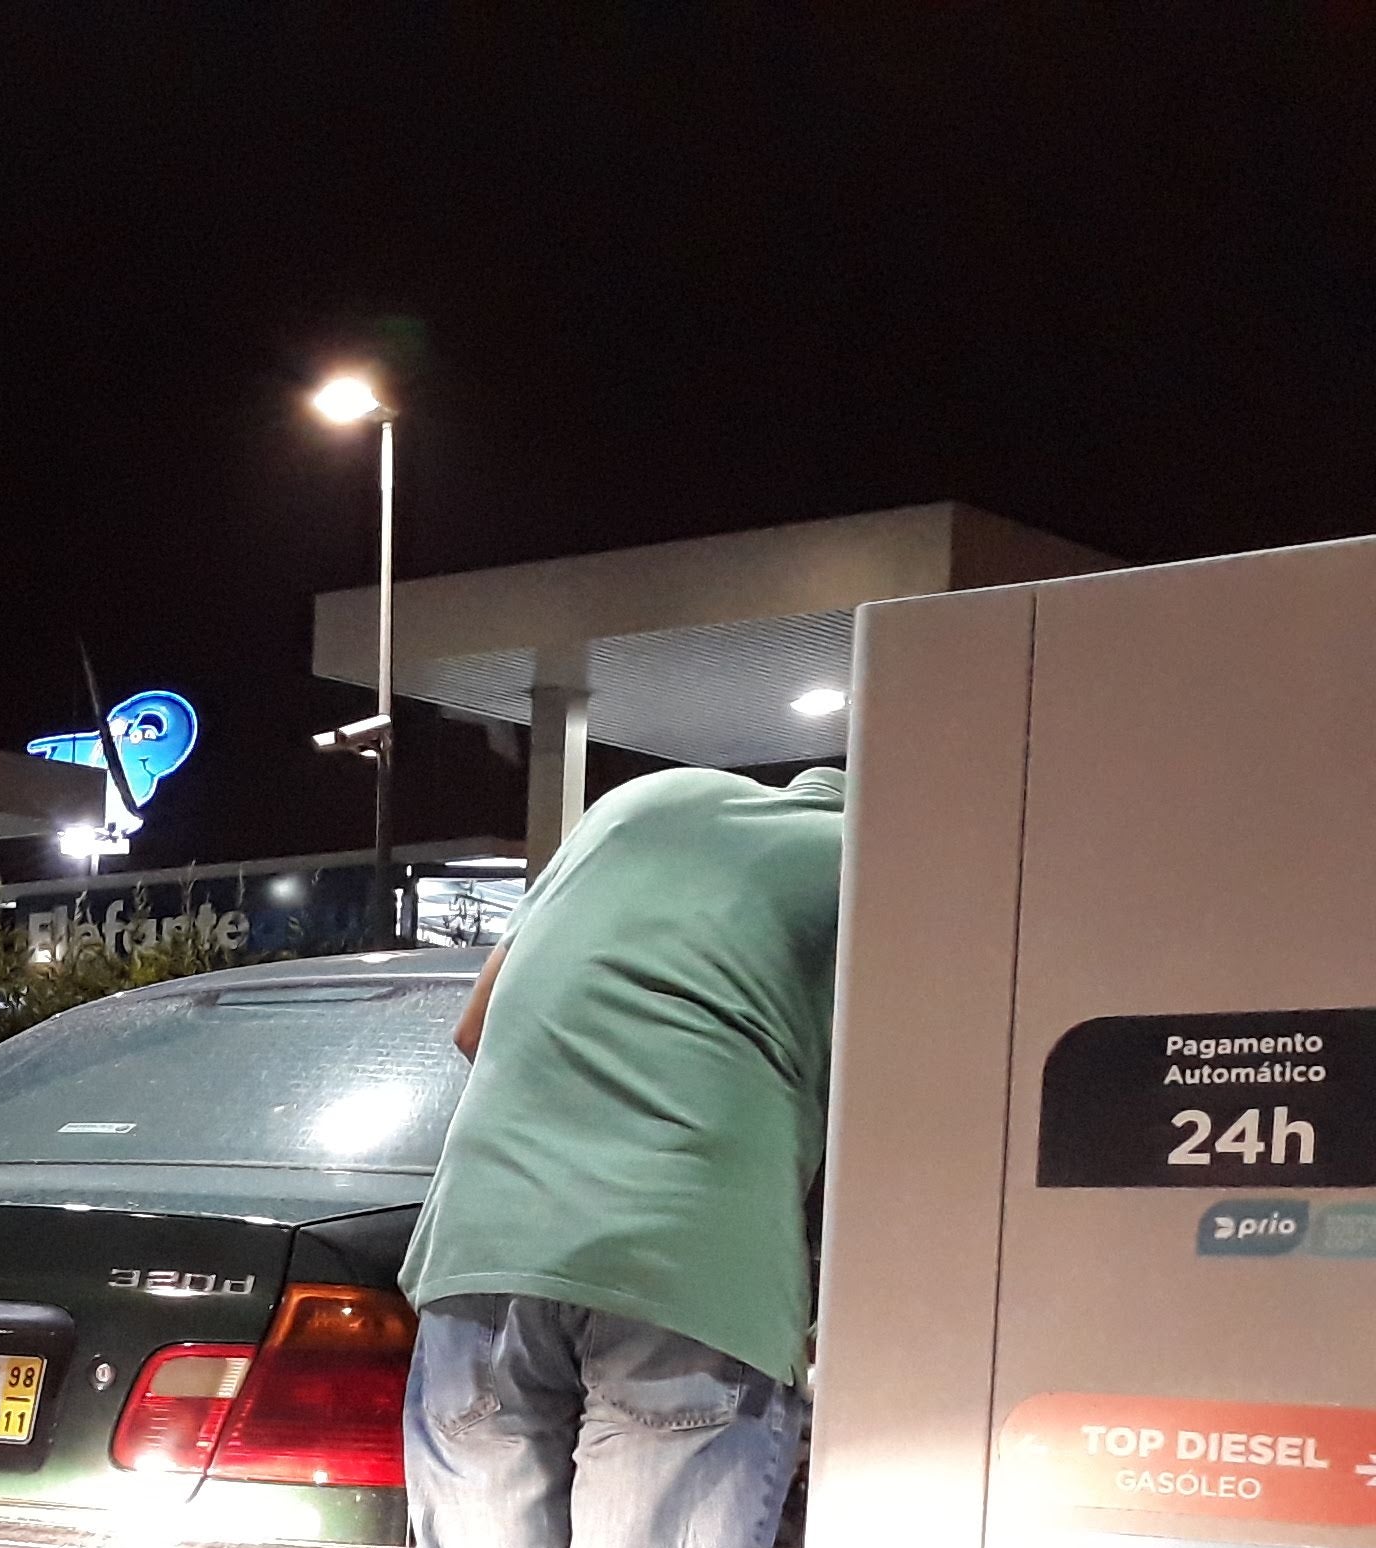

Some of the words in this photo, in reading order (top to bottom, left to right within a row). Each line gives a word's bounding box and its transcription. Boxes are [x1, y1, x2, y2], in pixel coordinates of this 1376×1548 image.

[1165, 1032, 1323, 1060] Pagamento
[1163, 1061, 1327, 1086] Automático
[1166, 1105, 1316, 1165] 24h
[1238, 1210, 1296, 1239] prio
[107, 1266, 256, 1296] 320d
[8, 1366, 35, 1389] 98
[2, 1410, 26, 1433] 11
[1081, 1425, 1165, 1458] TOP
[1176, 1430, 1330, 1470] DIESEL
[1114, 1469, 1263, 1500] GASÓLEO
